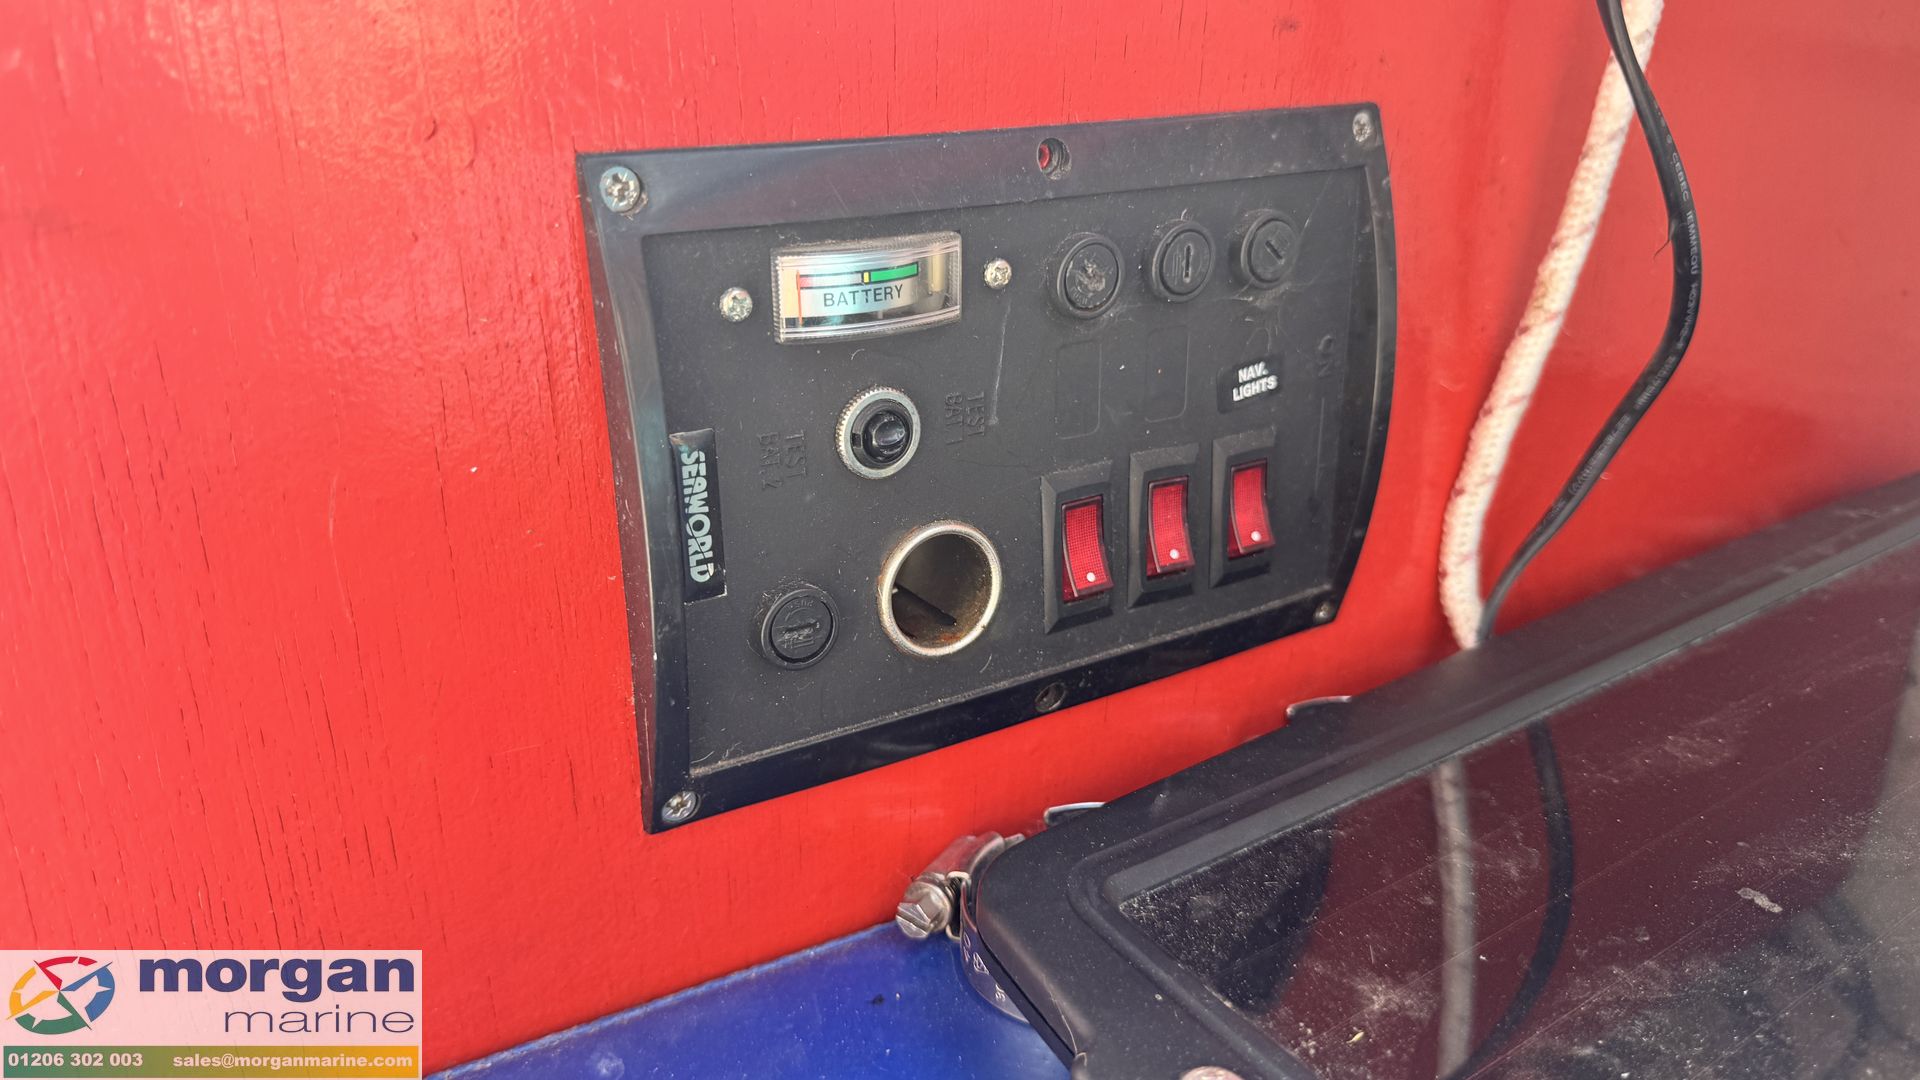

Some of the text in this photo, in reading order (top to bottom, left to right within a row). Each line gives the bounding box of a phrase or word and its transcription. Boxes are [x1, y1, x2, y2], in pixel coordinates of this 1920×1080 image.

[824, 284, 903, 307] BATTERY
[1232, 375, 1278, 402] LIGHTS
[1238, 361, 1269, 383] NAV.
[967, 391, 985, 437] TEST
[784, 430, 807, 478] TEST
[680, 450, 715, 583] SEAWORLD
